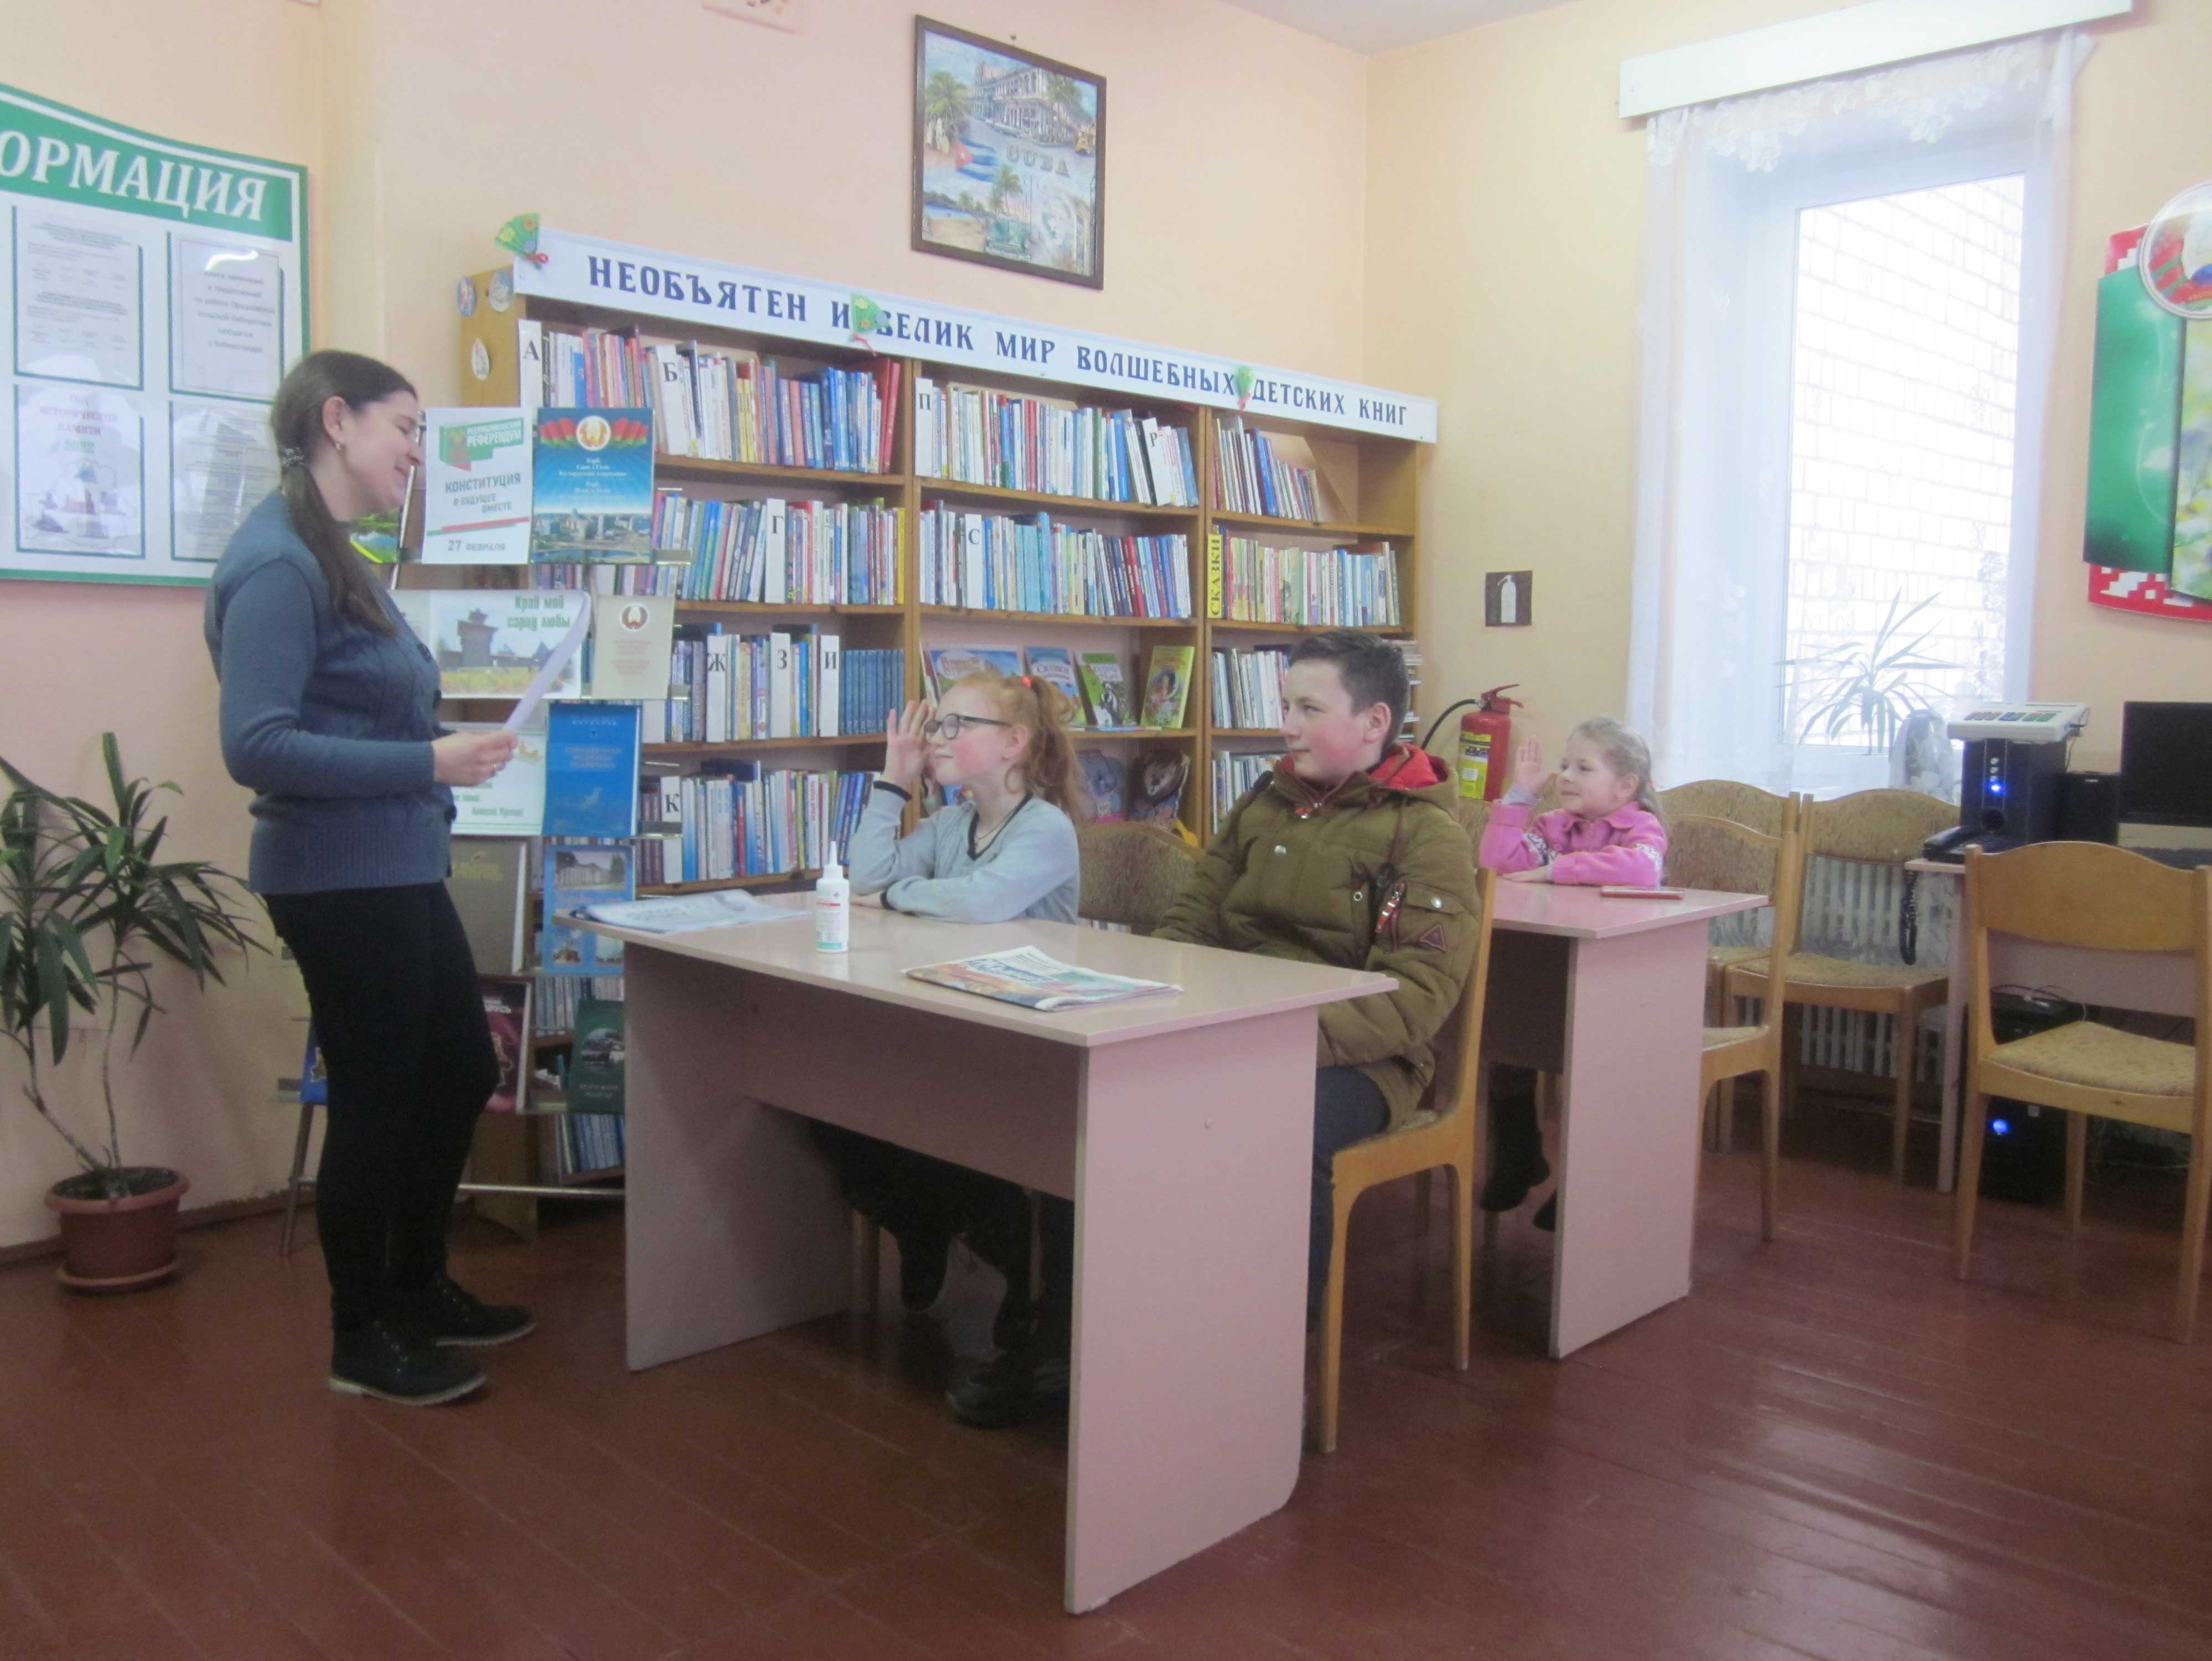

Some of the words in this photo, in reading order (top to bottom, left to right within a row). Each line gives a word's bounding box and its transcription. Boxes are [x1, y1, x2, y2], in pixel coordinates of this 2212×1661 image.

[1006, 145, 1071, 178] CUBA
[0, 131, 267, 221] ОРМАЦИЯ
[524, 339, 540, 361] А
[587, 255, 807, 322] НЕОБЪЯТЕН
[831, 301, 851, 330] И
[995, 331, 1055, 364] МИР
[1076, 345, 1236, 396] ВОЛШЕБНЫХ
[1252, 378, 1345, 415] ДЕТСКИХ
[1358, 398, 1407, 425] КНИГ
[663, 362, 678, 382] Б
[919, 394, 931, 410] П
[1149, 432, 1159, 447] Р
[445, 473, 521, 493] КОНСТИТУЦИЯ
[461, 493, 497, 505] БУДУЩЕЕ
[482, 502, 512, 513] ВМЕСТЕ
[772, 515, 784, 534] Г
[448, 539, 462, 551] 27
[465, 543, 506, 551] ФЕВРАЛЯ
[968, 528, 980, 545] С
[1210, 538, 1221, 616] СКАЗКИ
[708, 652, 726, 672] Ж
[777, 649, 788, 669] З
[824, 651, 837, 669] И
[665, 793, 680, 813] К
